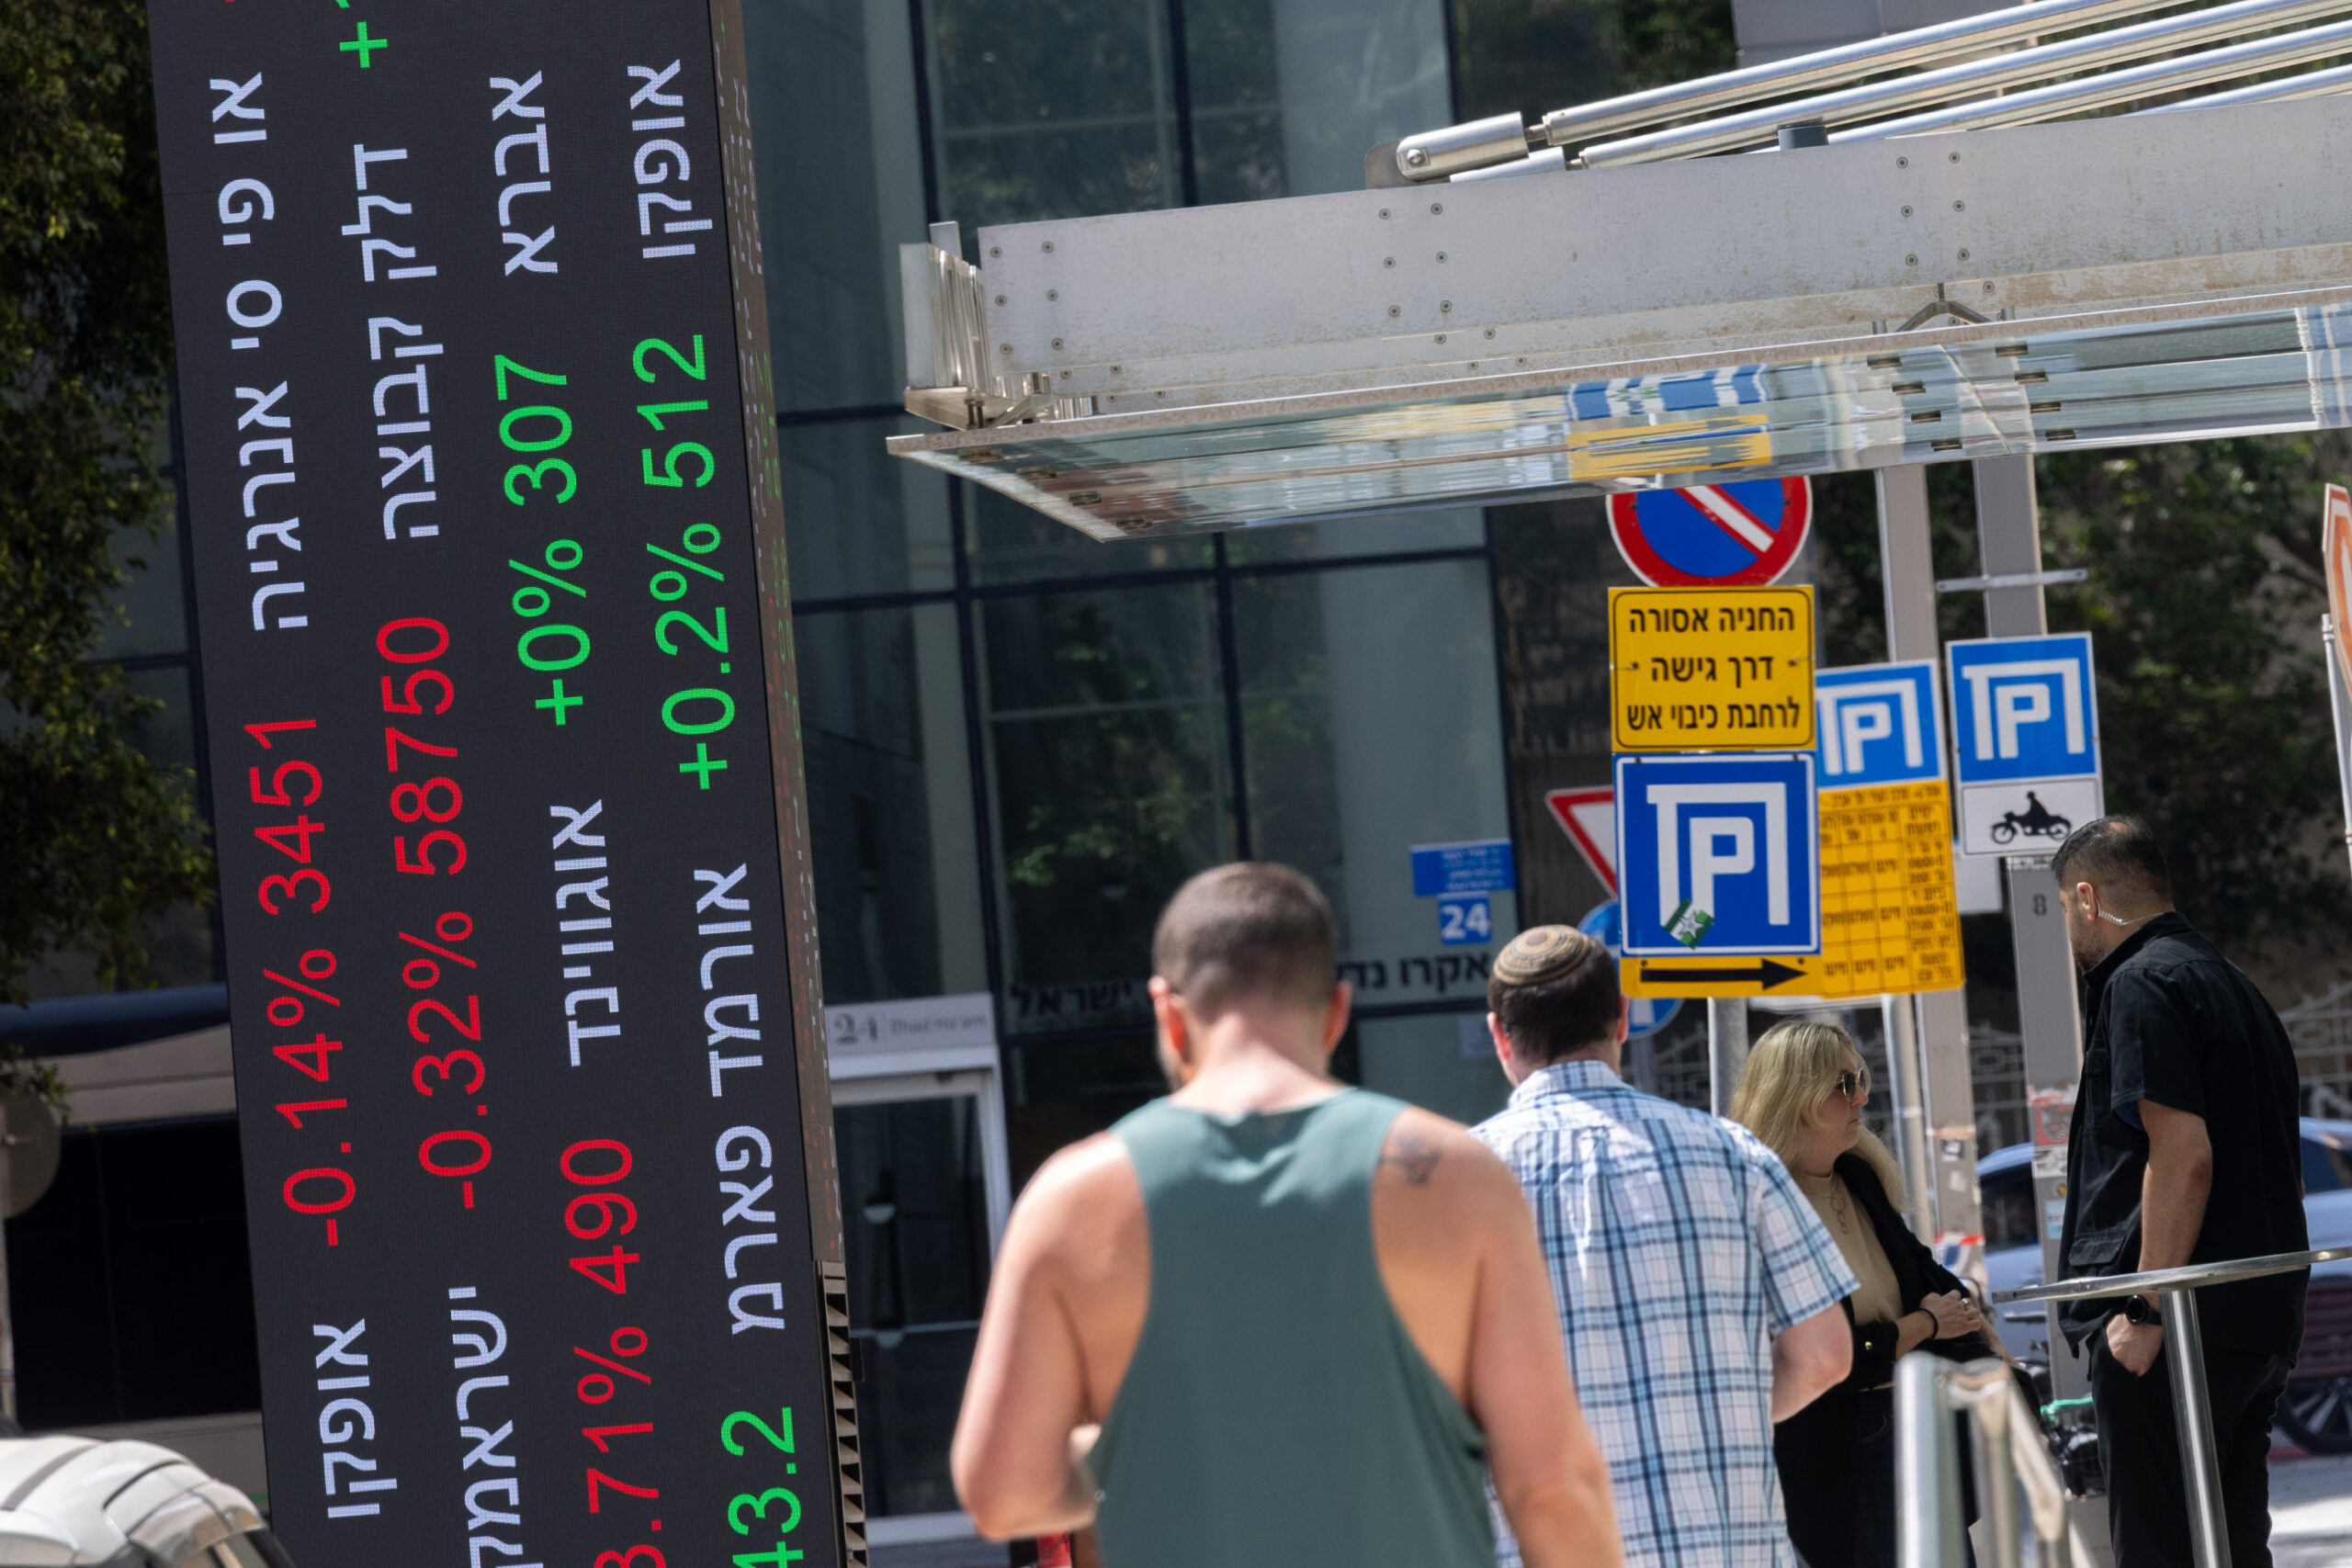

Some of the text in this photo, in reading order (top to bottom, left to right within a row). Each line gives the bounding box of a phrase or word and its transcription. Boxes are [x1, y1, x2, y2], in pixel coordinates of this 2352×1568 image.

[342, 144, 437, 282] דלק
[368, 317, 444, 540] קבוצה
[490, 71, 591, 726] אברא 307 +0%
[628, 60, 736, 790] אופקו 512 +0.2%
[209, 73, 356, 1247] או פי סי אנרגיה 3451 -0.14%
[1627, 695, 1800, 730] לרחבת כיבוי אש
[1630, 607, 1794, 632] החניה אסורה
[1651, 656, 1773, 688] דרך גישה
[376, 617, 467, 875] 58750
[550, 799, 620, 1067] אוגווינד
[694, 863, 763, 1098] אורמד
[1399, 952, 1490, 993] אקרו
[1440, 902, 1490, 940] 24
[399, 912, 492, 1209] -0.32%
[834, 1011, 878, 1044] 24
[560, 1138, 639, 1294] 490
[716, 1126, 786, 1335] פארמ
[313, 1318, 398, 1518] אופקו
